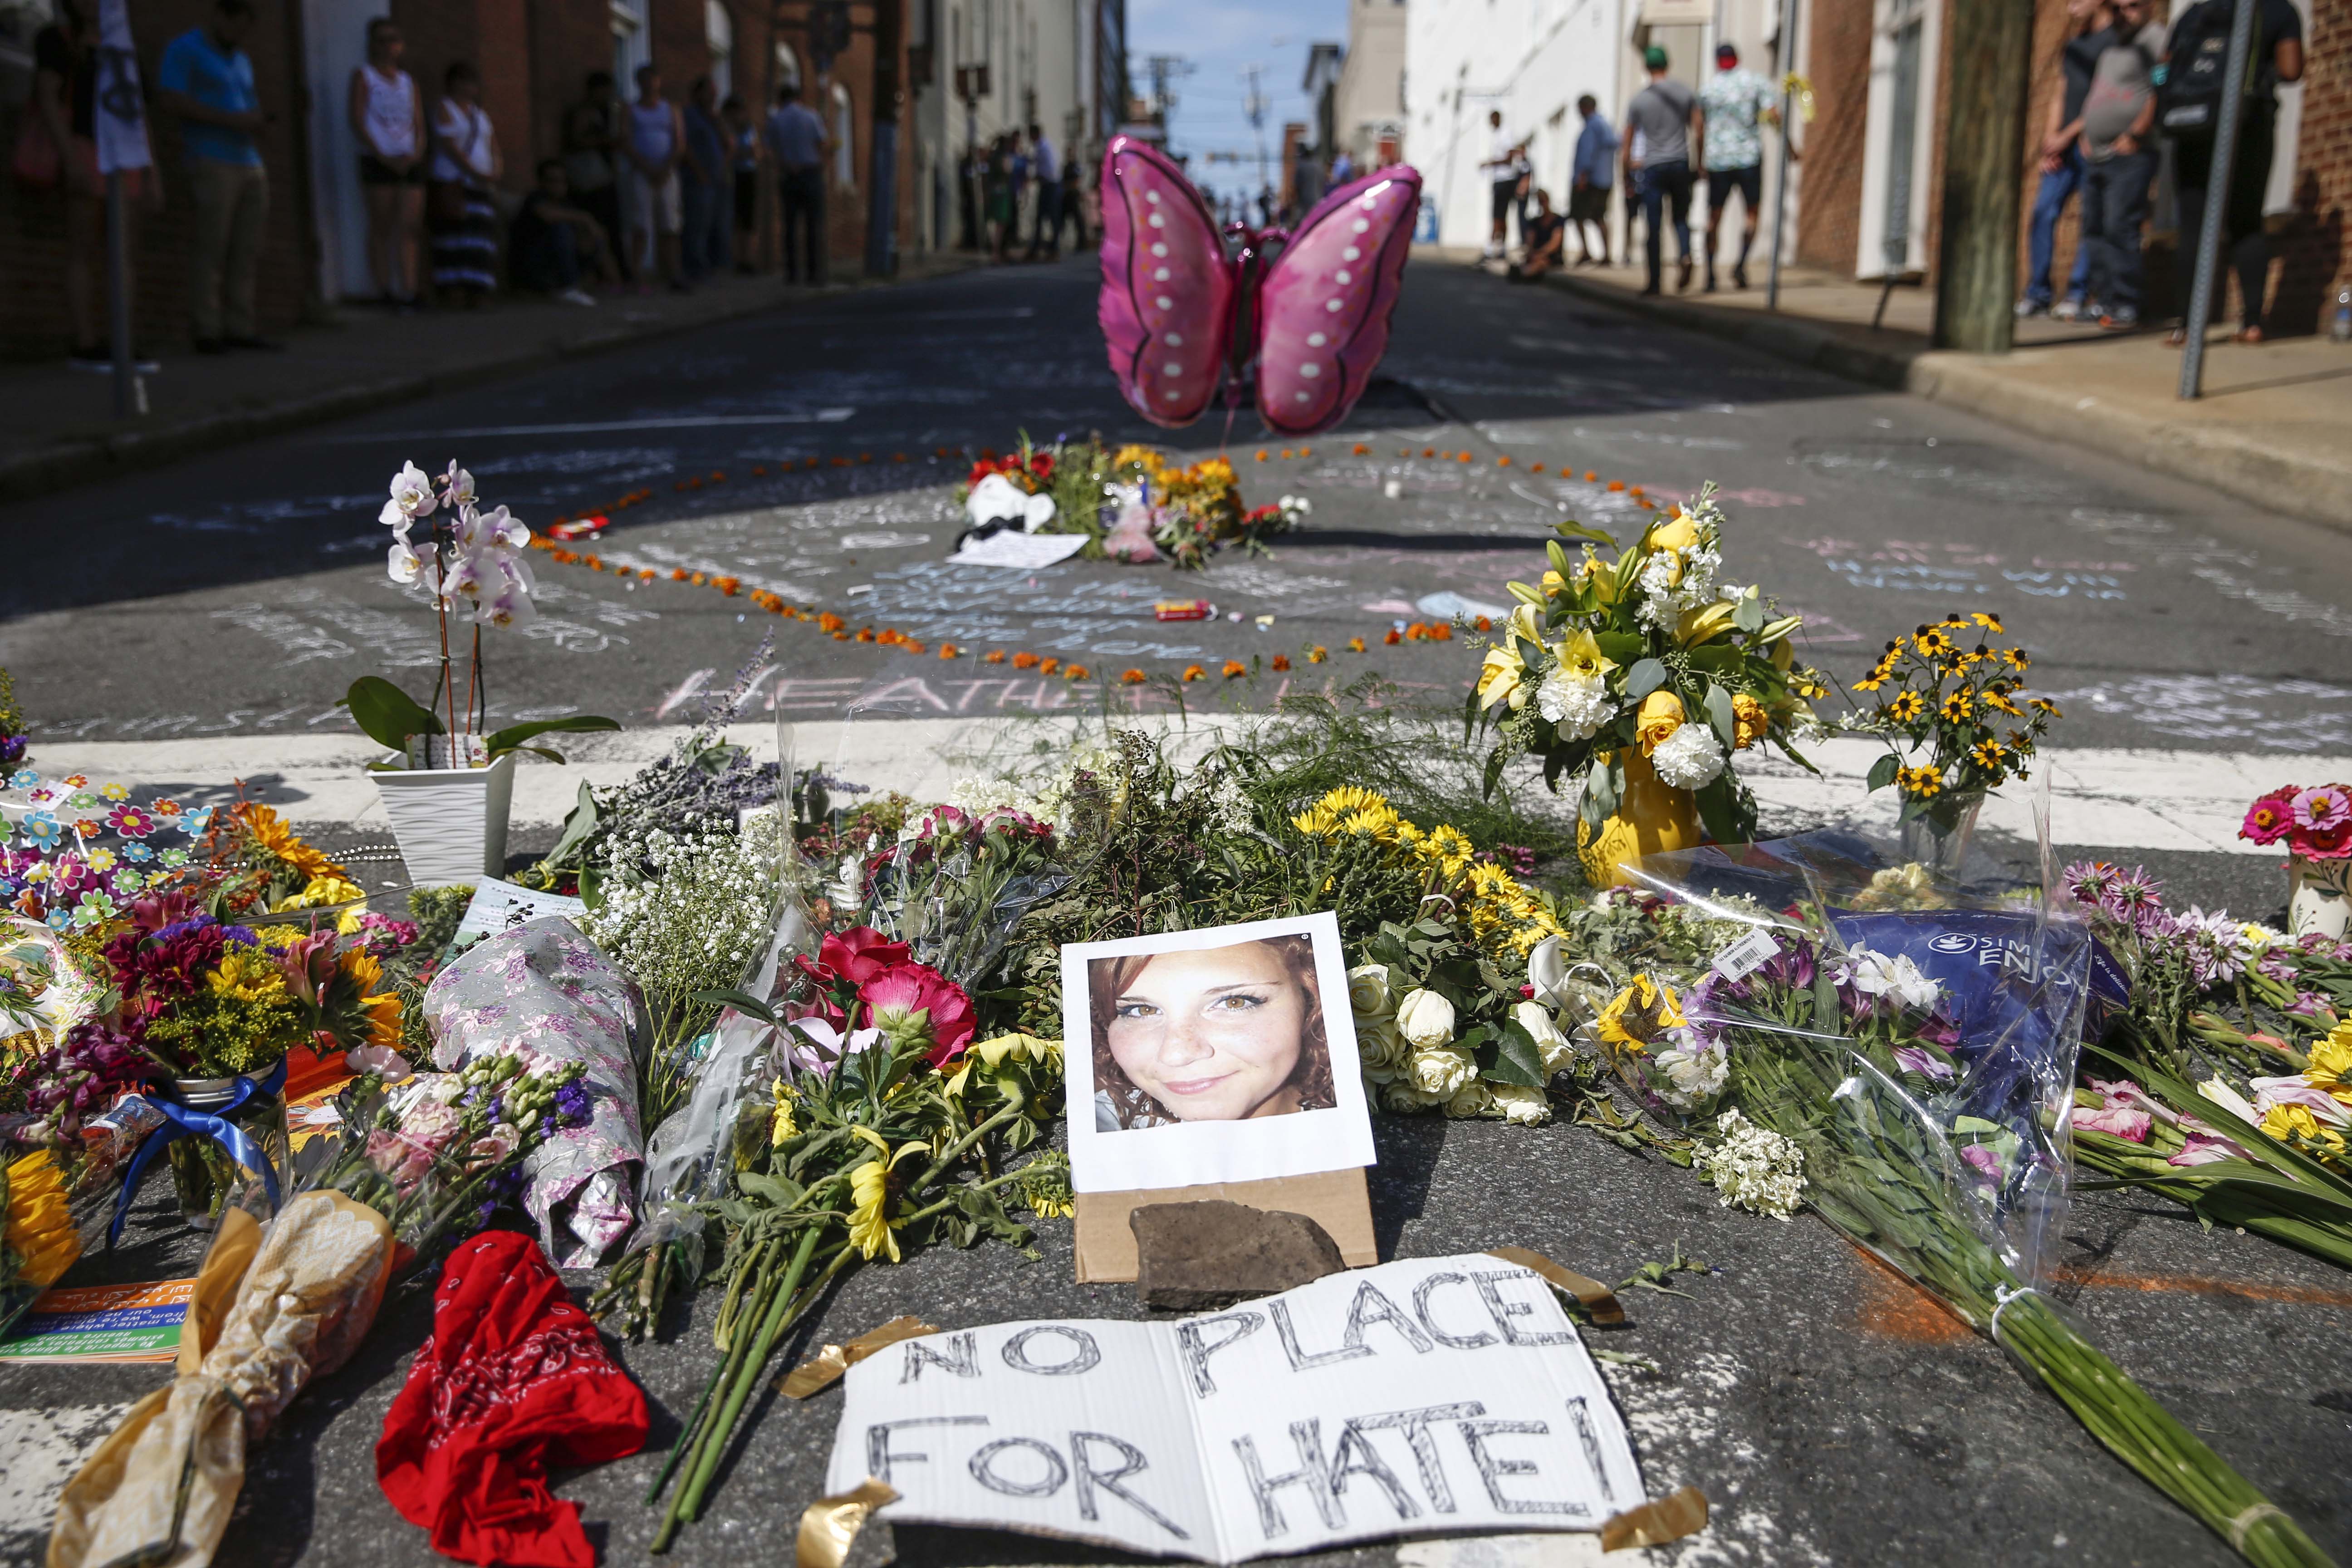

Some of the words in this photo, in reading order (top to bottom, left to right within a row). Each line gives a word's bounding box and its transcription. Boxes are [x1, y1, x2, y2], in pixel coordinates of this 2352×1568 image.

[1979, 948, 2076, 986] ENJO
[2094, 954, 2106, 968] Life
[111, 1319, 160, 1328] matter
[149, 1311, 185, 1319] from,
[899, 1325, 1101, 1385] NO
[1176, 1269, 1578, 1398] PLACE
[866, 1415, 1191, 1539] FOR
[1231, 1396, 1621, 1540] HATE!
